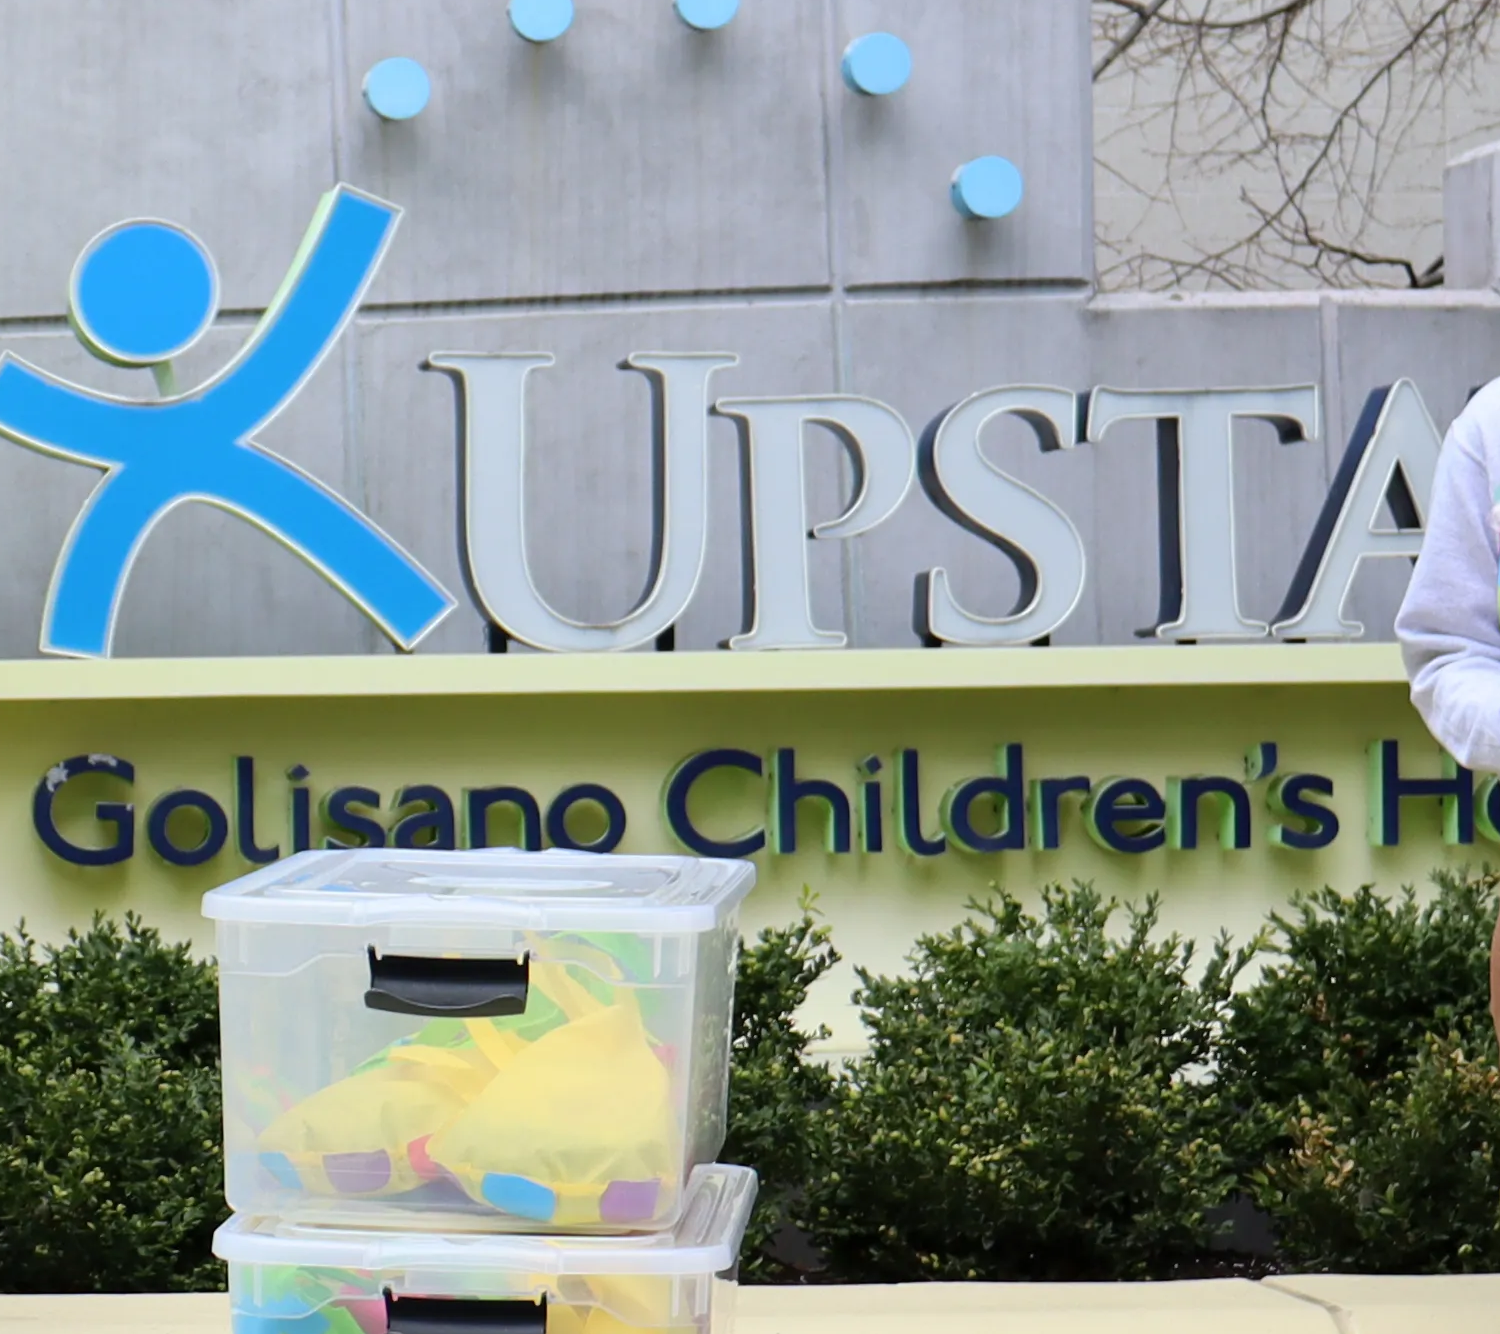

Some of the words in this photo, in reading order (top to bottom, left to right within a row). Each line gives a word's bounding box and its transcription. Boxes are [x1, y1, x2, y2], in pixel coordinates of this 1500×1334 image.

[425, 351, 1446, 654] UPSTA
[32, 751, 626, 867] Golisano
[664, 740, 1341, 864] Children's
